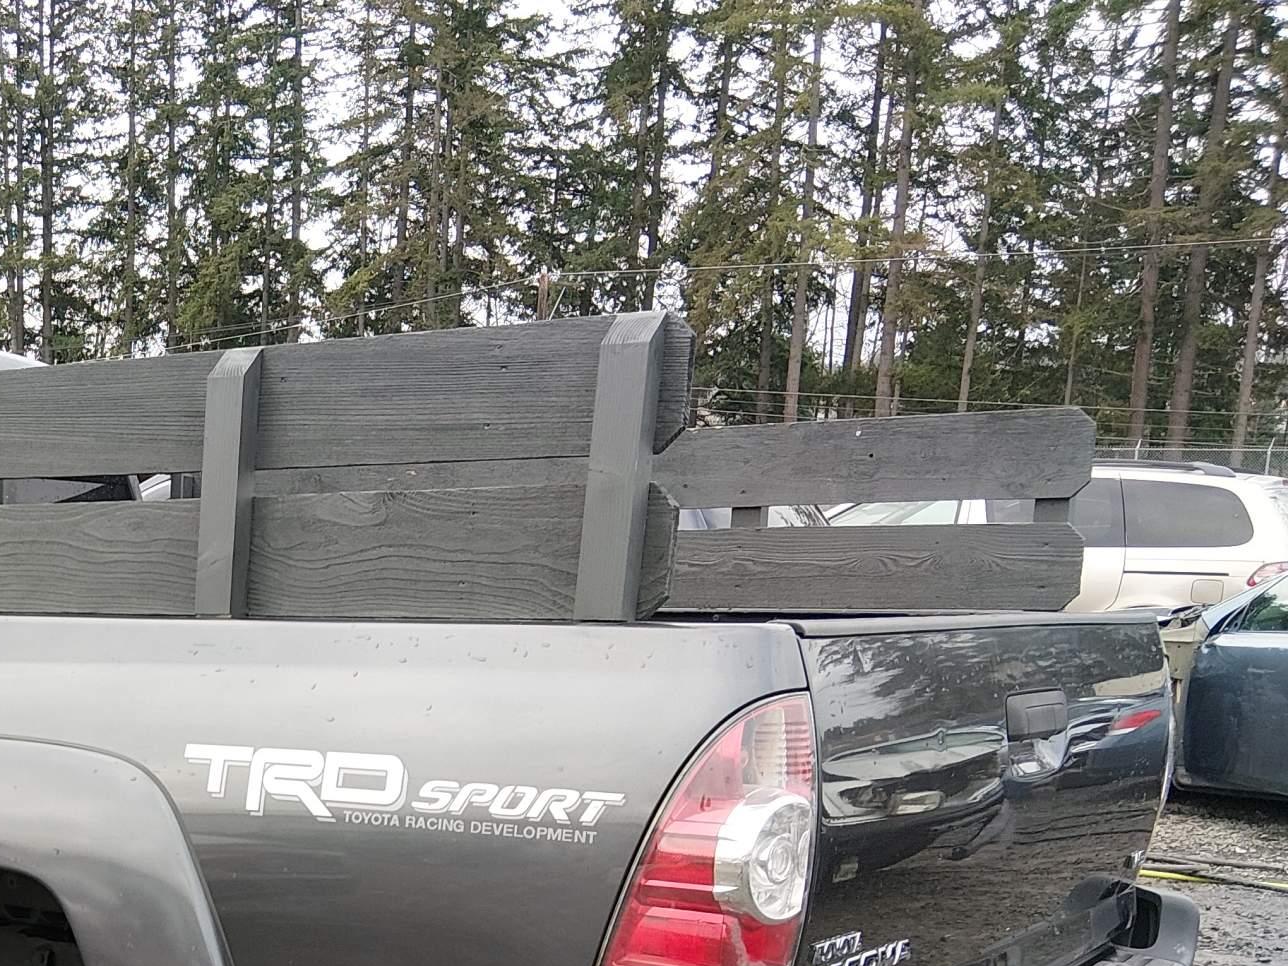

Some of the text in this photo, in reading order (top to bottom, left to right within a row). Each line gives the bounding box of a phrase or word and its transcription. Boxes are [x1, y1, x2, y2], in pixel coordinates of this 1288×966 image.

[184, 743, 626, 826] TRD SPORT
[343, 810, 598, 846] TOYOTA RACING DEVELOPMENT
